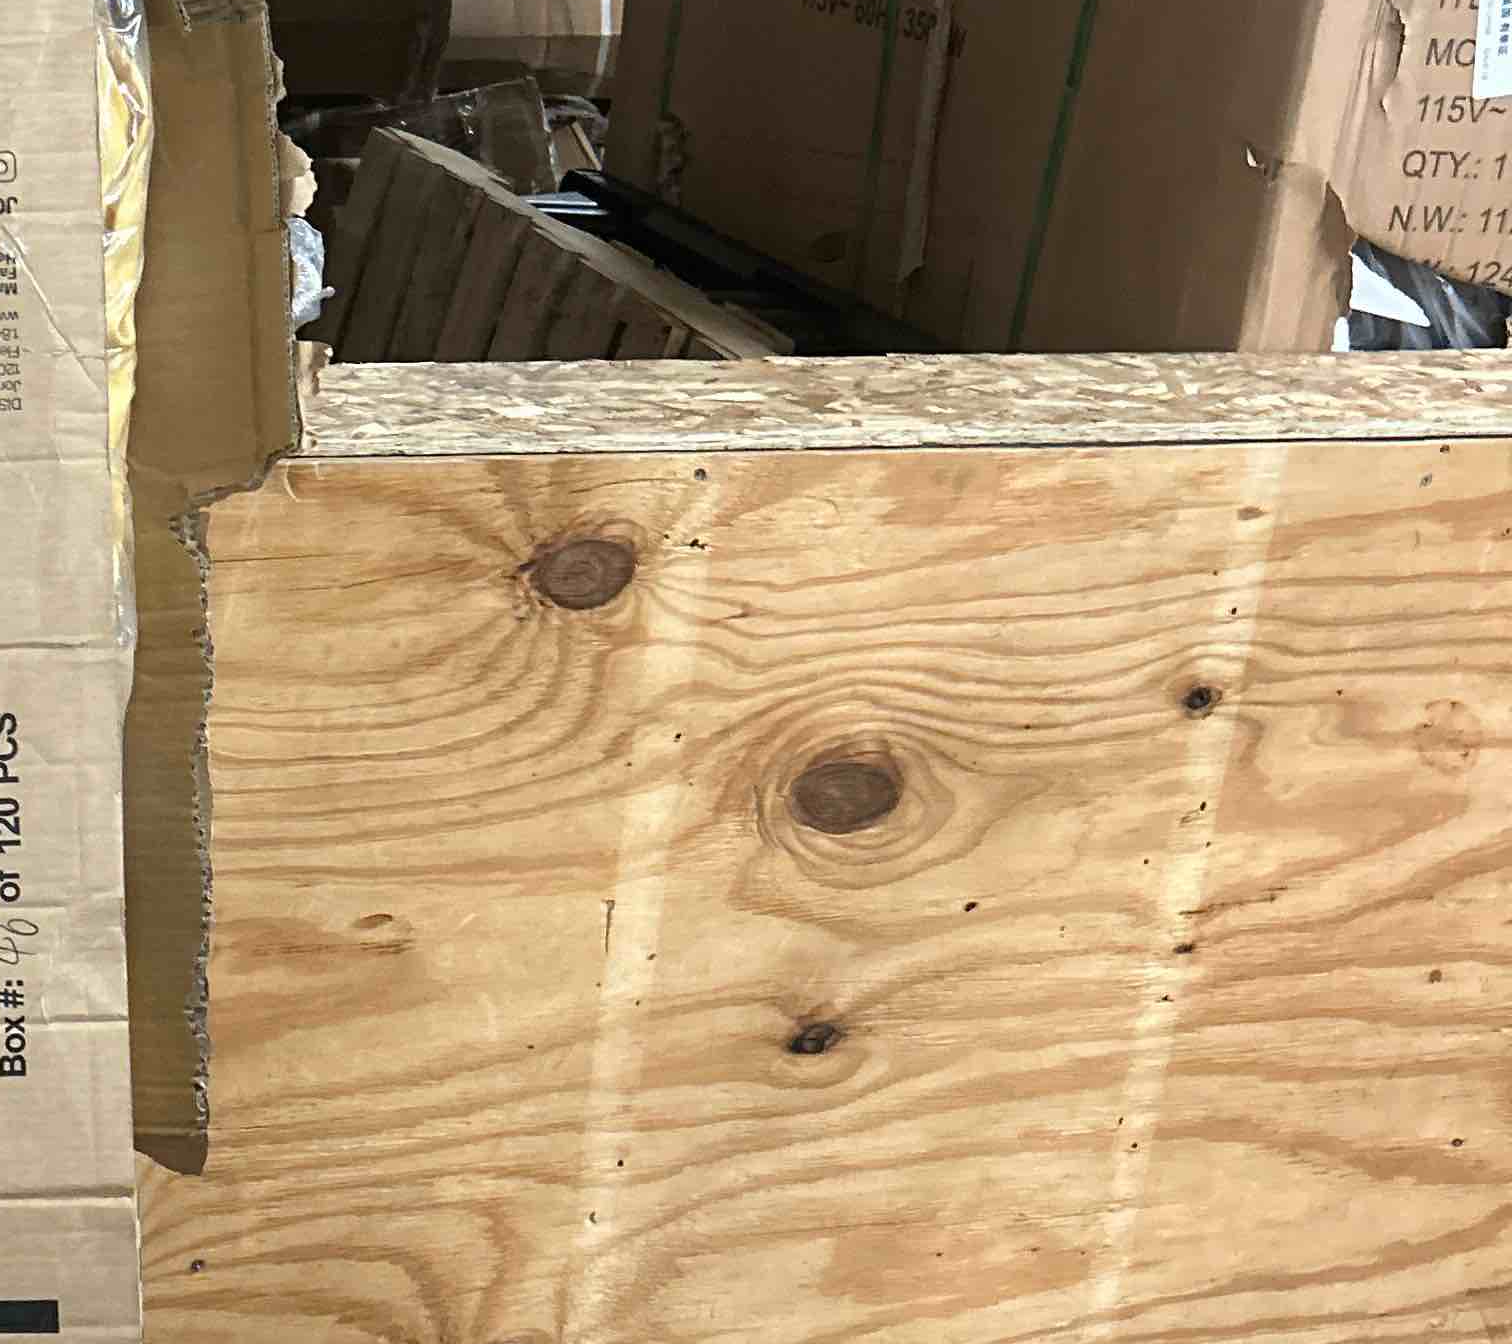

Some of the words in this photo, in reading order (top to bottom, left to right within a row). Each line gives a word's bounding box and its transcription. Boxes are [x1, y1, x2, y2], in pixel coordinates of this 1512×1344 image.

[1401, 149, 1481, 180] QTY.:
[1494, 153, 1508, 180] 1
[1388, 204, 1468, 234] N.W.:
[1480, 207, 1512, 235] 11
